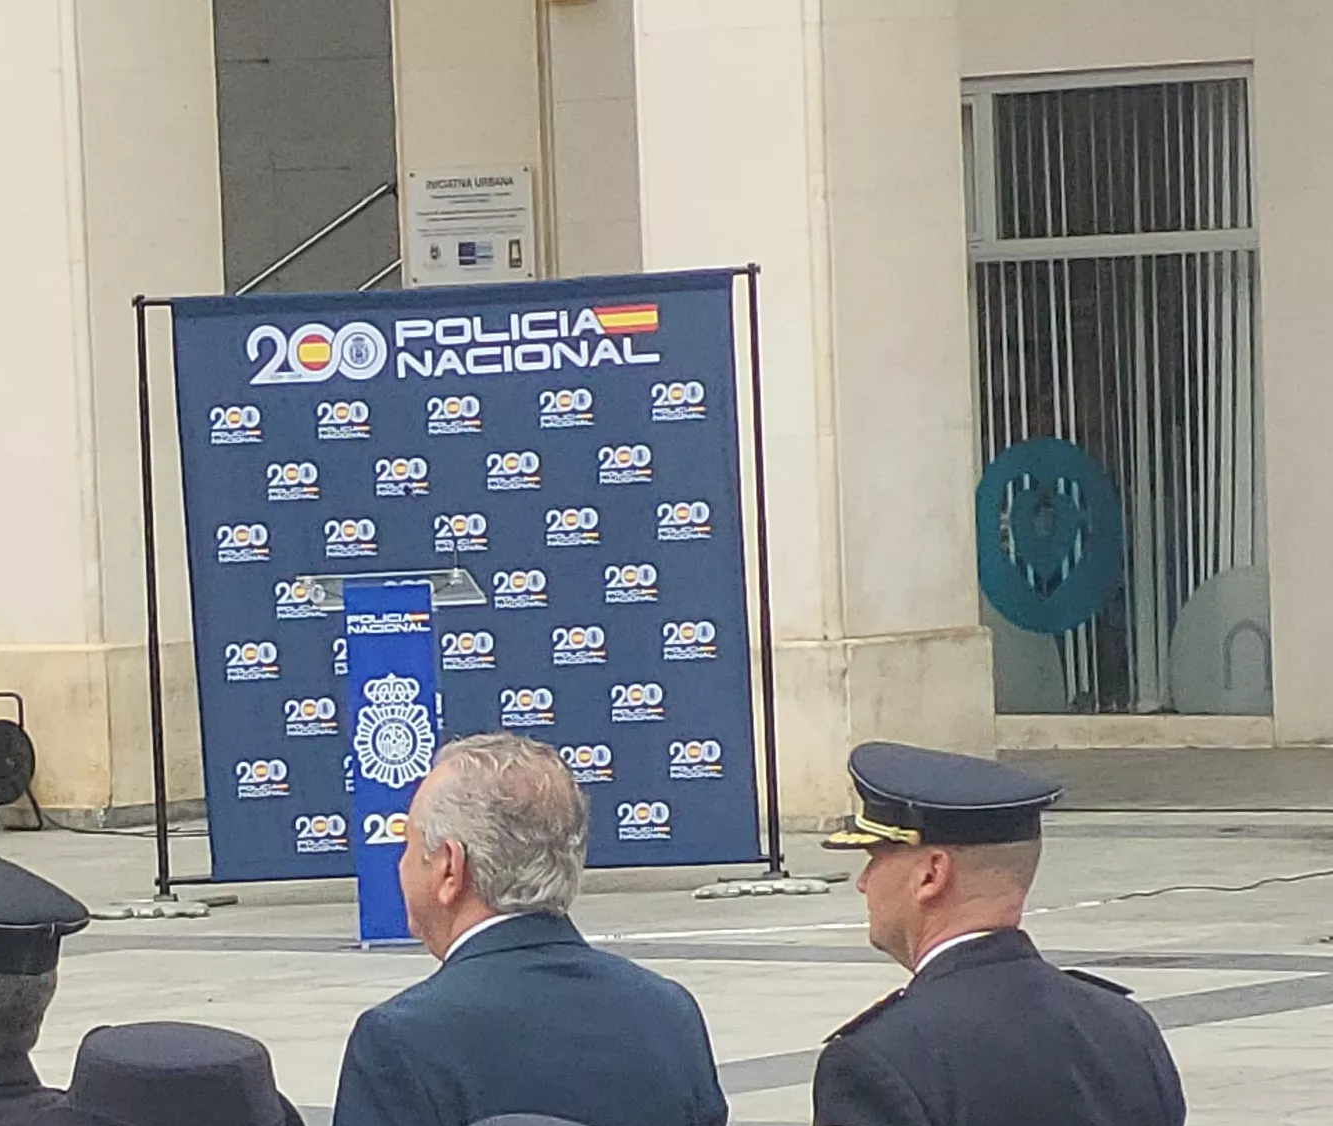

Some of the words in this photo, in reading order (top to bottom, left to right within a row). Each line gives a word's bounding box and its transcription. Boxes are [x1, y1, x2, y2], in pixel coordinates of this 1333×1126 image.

[246, 321, 388, 386] 200
[395, 337, 660, 379] NACIONAL
[540, 389, 591, 413] 200
[651, 380, 702, 404] 200
[210, 406, 261, 430] 200
[317, 401, 368, 425] 200
[427, 396, 478, 420] 200
[487, 452, 538, 476] 200
[598, 445, 649, 469] 200
[267, 463, 318, 487] 200
[376, 458, 427, 482] 200
[546, 508, 597, 532] 200
[657, 502, 708, 526] 200
[217, 524, 268, 548] 200
[325, 519, 376, 543] 200
[493, 570, 544, 594] 200
[605, 564, 656, 588] 200
[347, 621, 431, 635] NACIONAL
[552, 626, 603, 650] 200
[663, 622, 714, 646] 200
[226, 642, 277, 666] 200
[442, 632, 493, 656] 200
[501, 688, 552, 712] 200
[611, 684, 662, 708] 200
[285, 698, 336, 722] 200
[670, 741, 721, 765] 200
[236, 760, 287, 784] 200
[618, 802, 669, 826] 200
[296, 815, 347, 839] 200
[363, 812, 408, 844] 20
